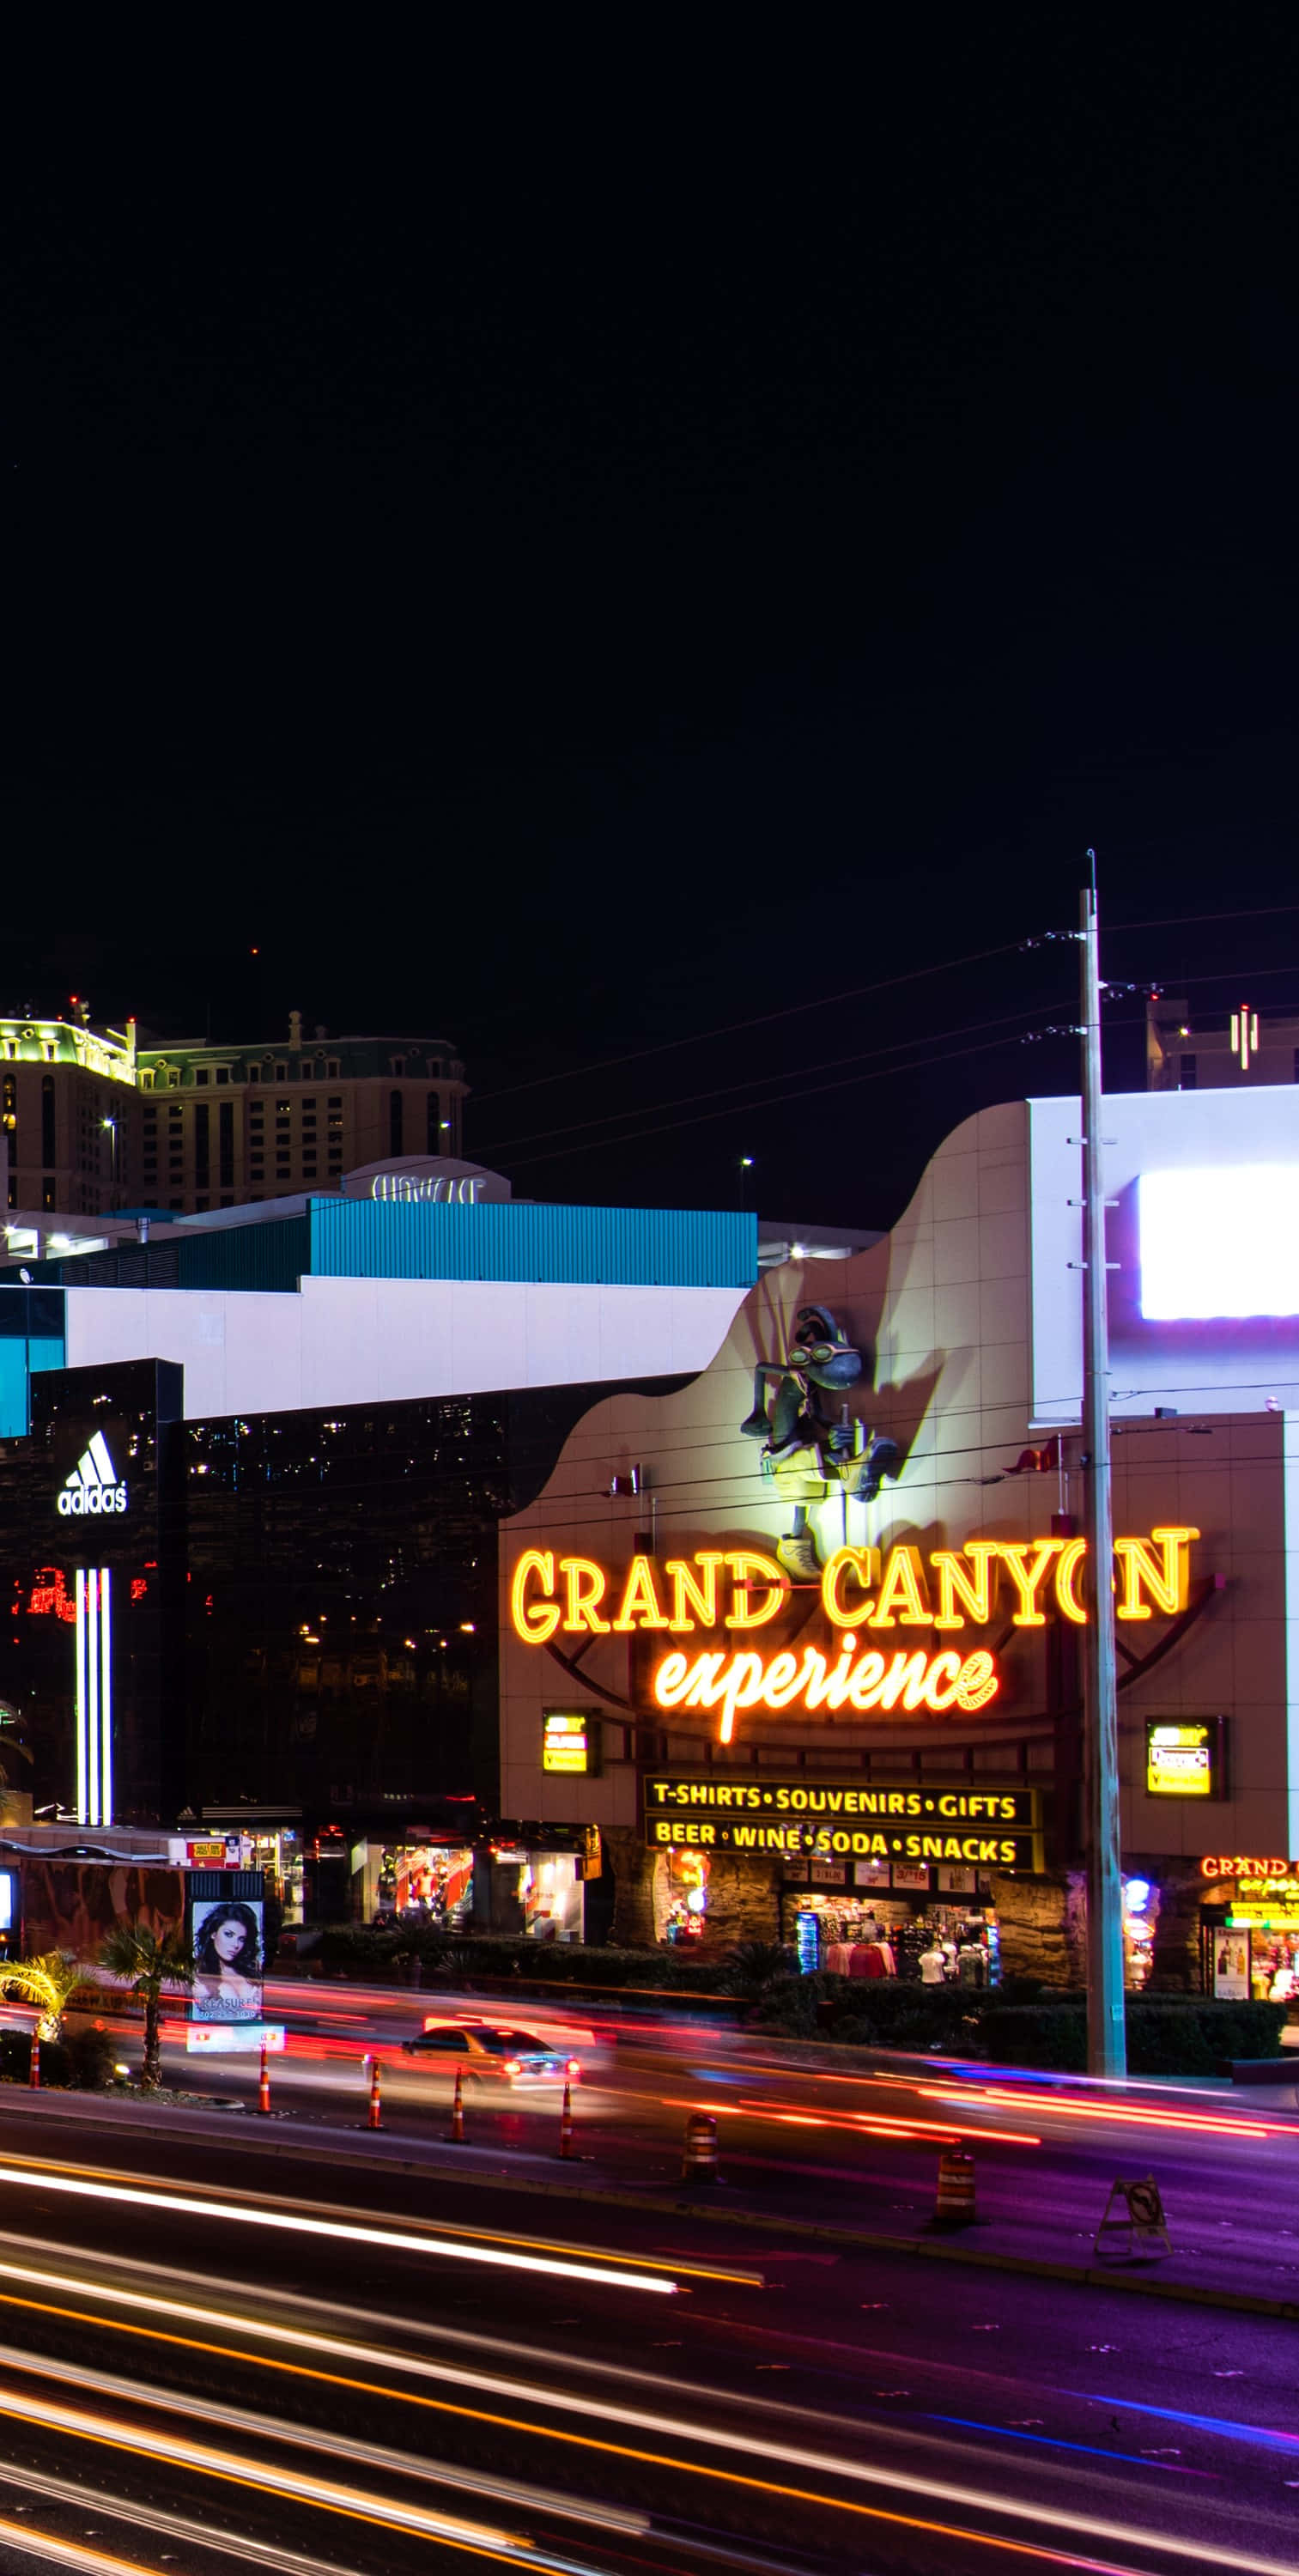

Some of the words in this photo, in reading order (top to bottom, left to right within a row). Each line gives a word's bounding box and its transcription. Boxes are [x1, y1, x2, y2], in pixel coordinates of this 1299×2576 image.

[58, 1484, 126, 1516] adidas
[512, 1550, 789, 1643] GRAND
[655, 1633, 998, 1743] experience
[653, 1783, 761, 1807] T-SHIRTS
[776, 1789, 921, 1815] SOUVENIRS
[938, 1795, 1017, 1819] GIFTS
[655, 1822, 715, 1844] BEER
[733, 1827, 800, 1850] WINE
[816, 1830, 888, 1856] SODA
[906, 1835, 1017, 1862] SNACKS
[1201, 1856, 1288, 1878] GRAND
